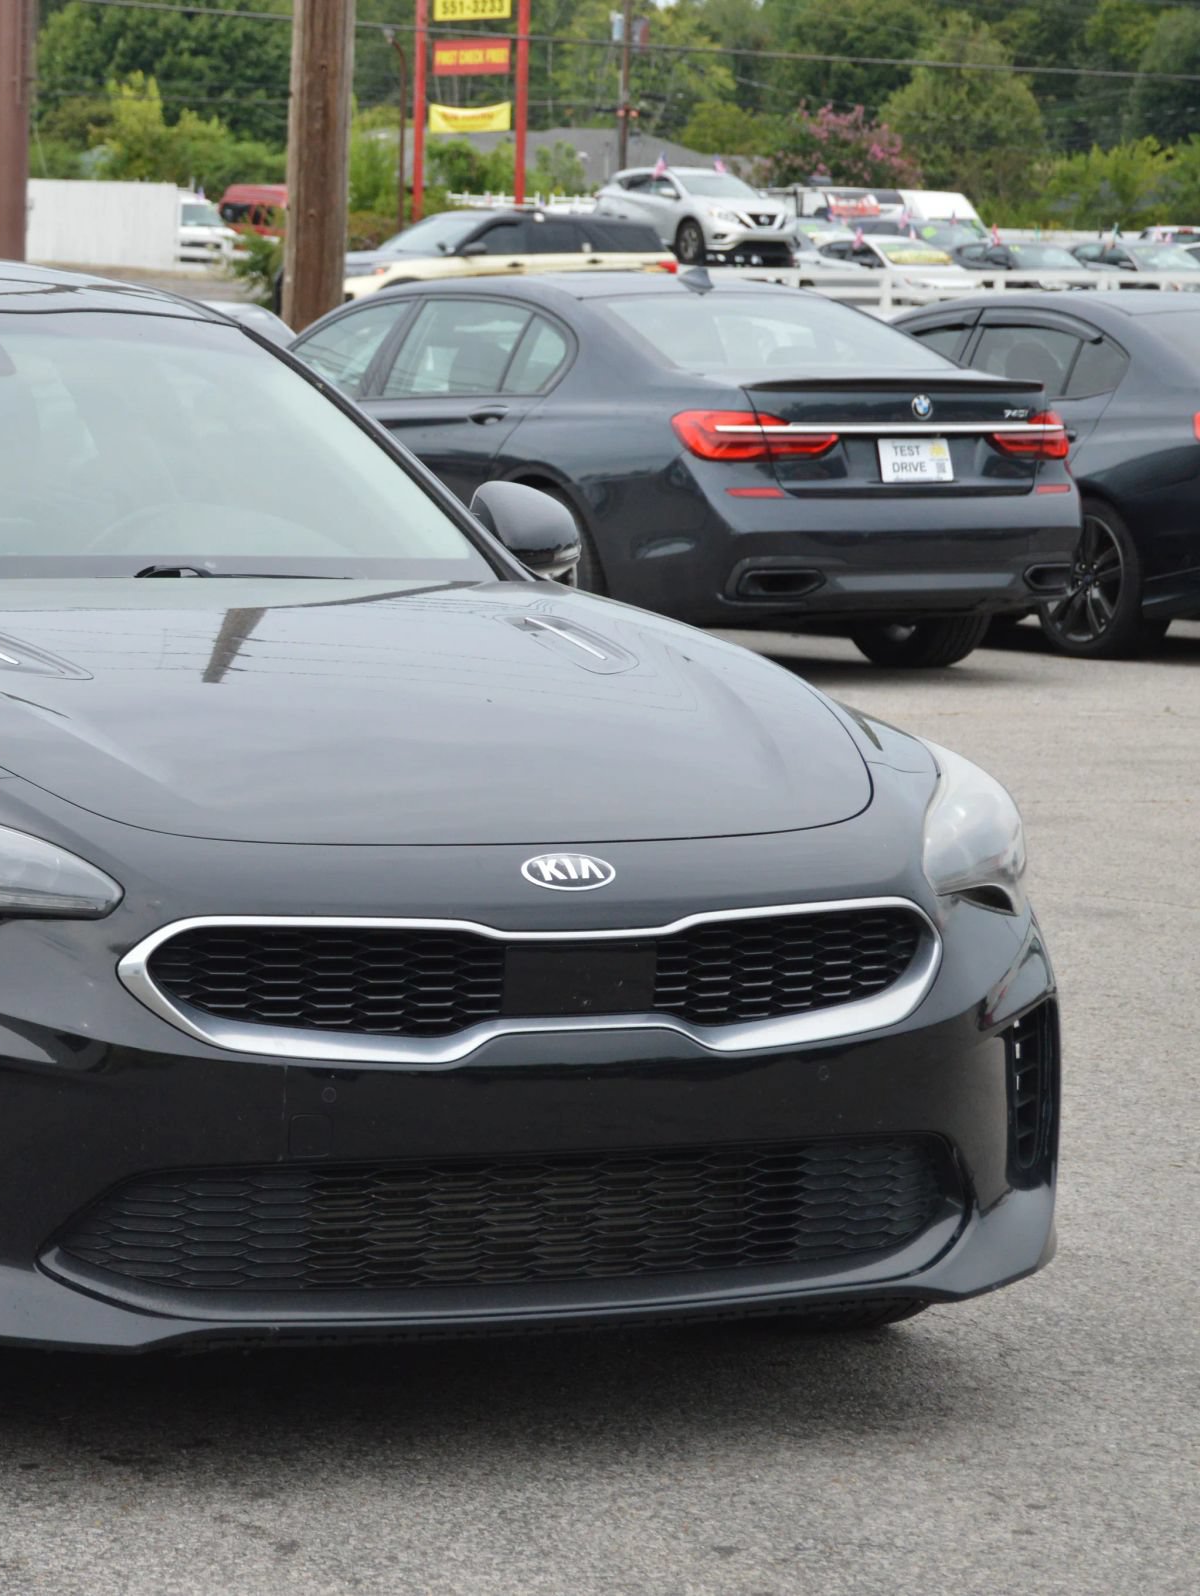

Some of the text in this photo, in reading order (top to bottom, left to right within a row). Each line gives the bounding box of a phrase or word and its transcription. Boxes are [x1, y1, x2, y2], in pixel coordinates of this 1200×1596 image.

[441, 0, 504, 15] 551-3233
[892, 445, 921, 457] TEST
[892, 461, 928, 473] DRIVE
[535, 857, 605, 882] KIA
